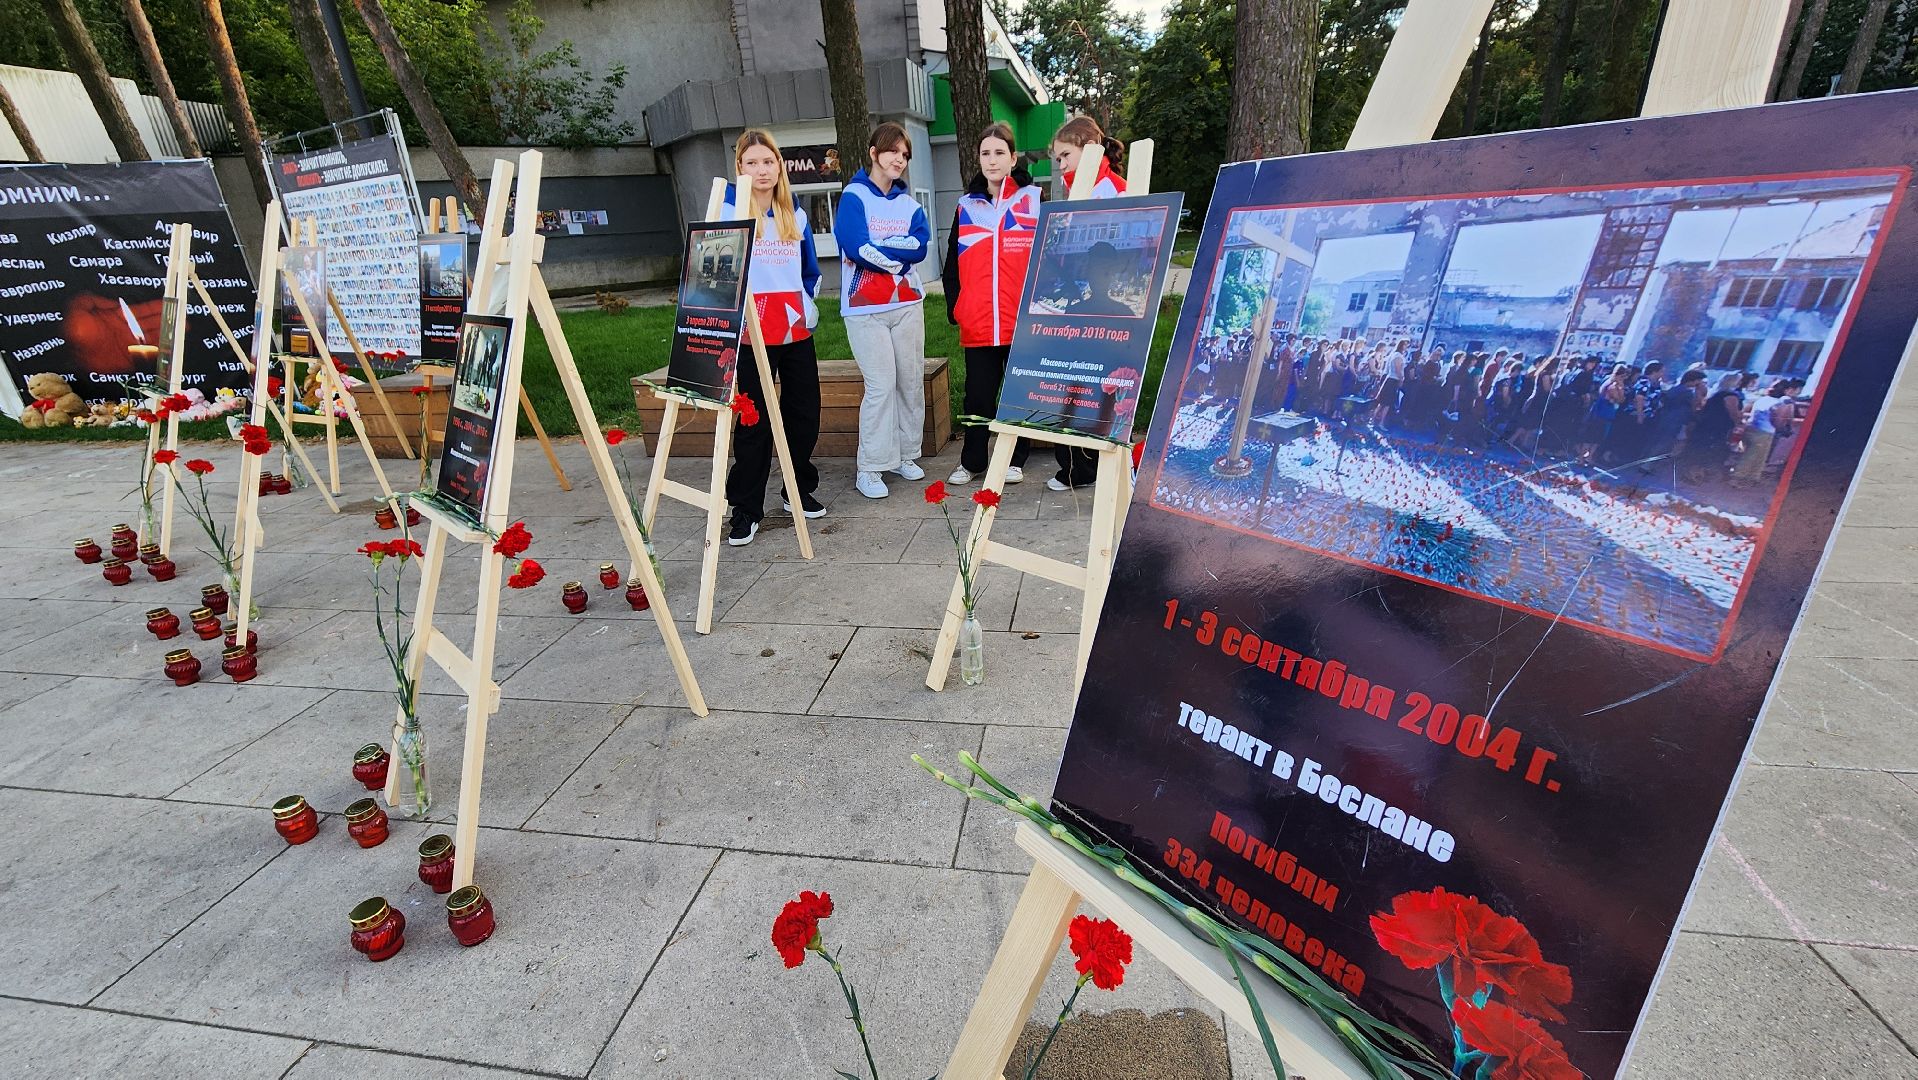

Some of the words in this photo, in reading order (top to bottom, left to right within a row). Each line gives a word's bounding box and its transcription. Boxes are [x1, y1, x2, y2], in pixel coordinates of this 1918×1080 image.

[47, 222, 97, 246] Кизляр
[155, 220, 219, 243] Арвир
[103, 238, 171, 251] Каспийск
[69, 255, 123, 268] Самара
[154, 251, 215, 265] Грный
[0, 279, 66, 298] аврополь
[98, 272, 168, 288] Хасавюрт
[186, 301, 246, 316] Ворнеж
[203, 324, 255, 350] Буйакс
[1031, 323, 1042, 335] 17
[1042, 324, 1080, 340] октября
[1081, 326, 1106, 339] 2018
[1106, 328, 1130, 342] года
[13, 337, 65, 361] Назрань
[1040, 357, 1069, 369] Массовое
[1069, 360, 1099, 371] убийство
[1099, 363, 1104, 371] в
[1011, 366, 1045, 378] Керченском
[1045, 371, 1100, 384] политехническом
[1100, 377, 1135, 388] колледже
[1039, 381, 1058, 392] Погиб
[1057, 382, 1066, 392] 21
[1028, 391, 1064, 404] Пострадали
[1063, 396, 1072, 405] 67
[1221, 626, 1396, 721] сентября
[1398, 692, 1522, 773] 2004
[1177, 701, 1273, 768] теракт
[1271, 748, 1295, 780] в
[1296, 756, 1456, 863] Беслане
[1209, 810, 1340, 913] Погибли
[1162, 837, 1213, 889] 334
[1214, 874, 1366, 997] человека
